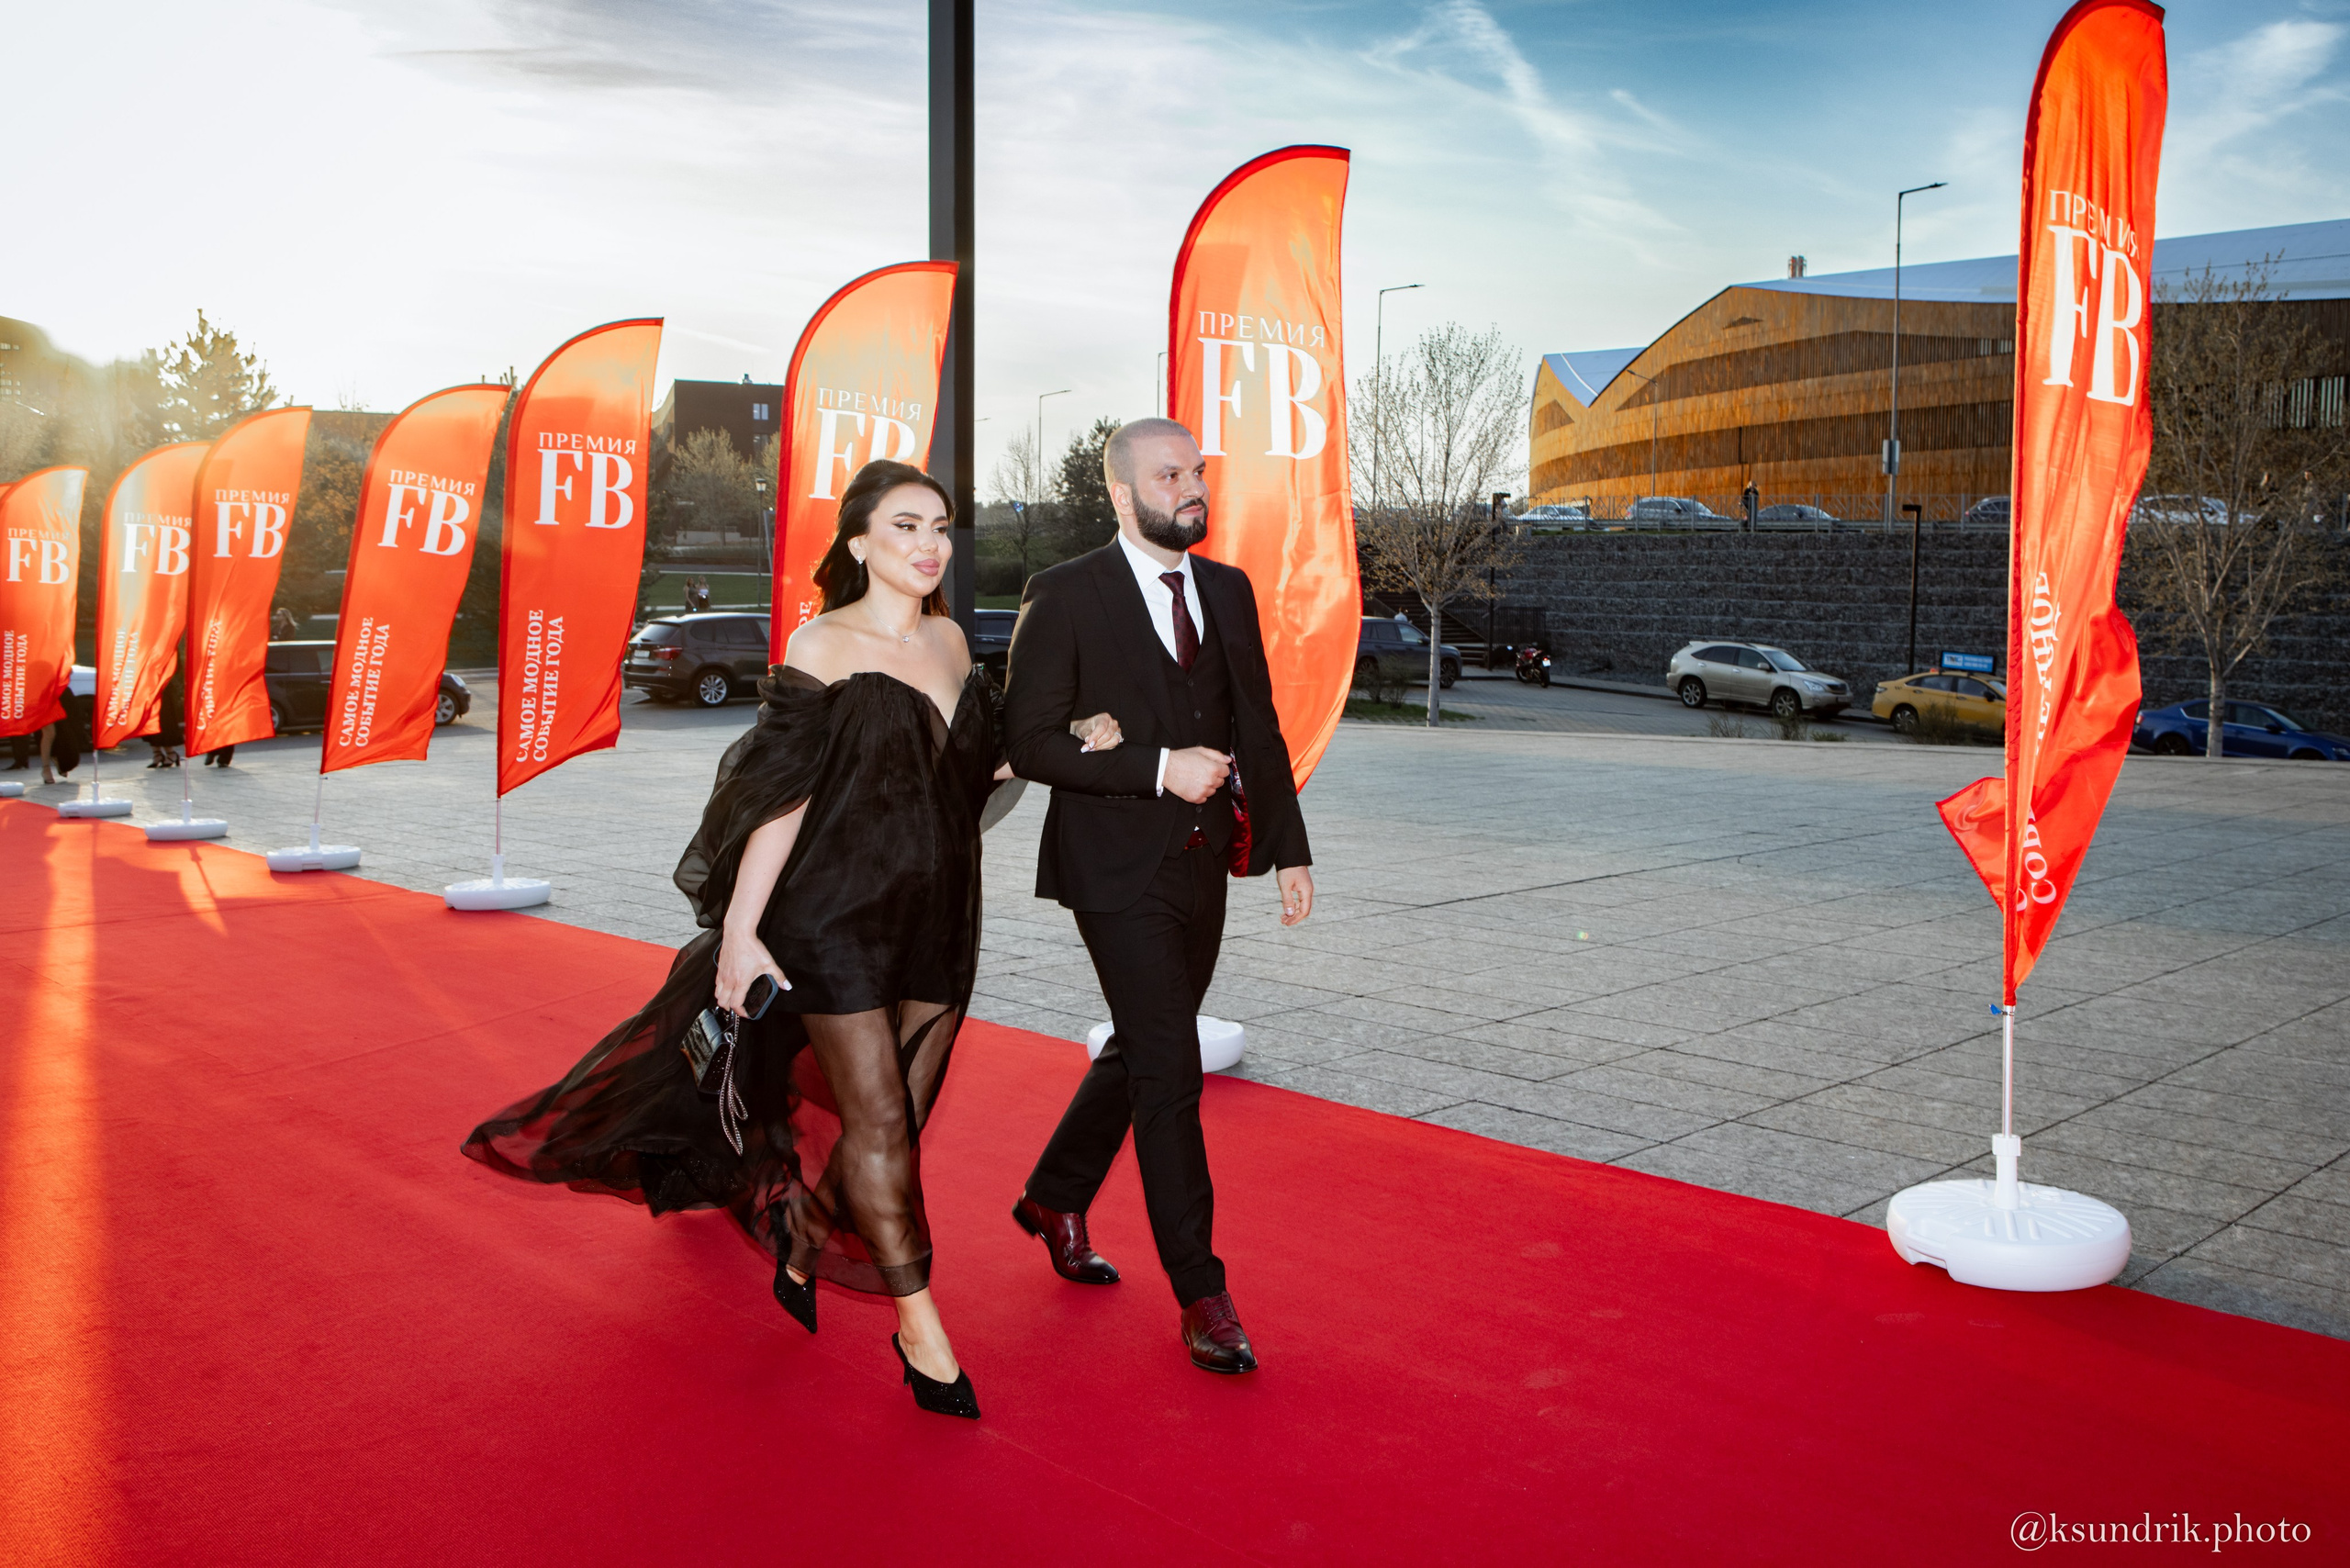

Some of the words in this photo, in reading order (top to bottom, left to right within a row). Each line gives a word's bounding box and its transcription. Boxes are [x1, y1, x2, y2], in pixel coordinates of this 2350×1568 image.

[2049, 189, 2140, 261] ПРЕМИЯ
[1197, 310, 1326, 348] ПРЕМИЯ
[2042, 224, 2142, 406] FB
[819, 387, 922, 421] ПРЕМИЯ
[1197, 336, 1327, 460] FB
[538, 431, 637, 455] ПРЕМИЯ
[215, 488, 290, 505] ПРЕМИЯ
[390, 469, 476, 496] ПРЕМИЯ
[534, 449, 633, 529] FB
[213, 501, 286, 558] FB
[377, 483, 470, 555] FB
[6, 537, 70, 585] FB
[120, 523, 191, 576] FB
[3, 630, 15, 679] МОДНОЕ
[17, 633, 28, 664] ГОДА
[522, 610, 543, 694] МОДНОЕ
[545, 616, 565, 666] ГОДА
[1, 680, 13, 720] САМОЕ
[14, 665, 26, 720] СОБЫТИЕ
[339, 690, 360, 747] САМОЕ
[350, 617, 374, 688] МОДНОЕ
[355, 668, 382, 747] СОБЫТИЕ
[369, 624, 390, 666] ГОДА
[516, 697, 536, 762] САМОЕ
[532, 670, 559, 762] СОБЫТИЕ
